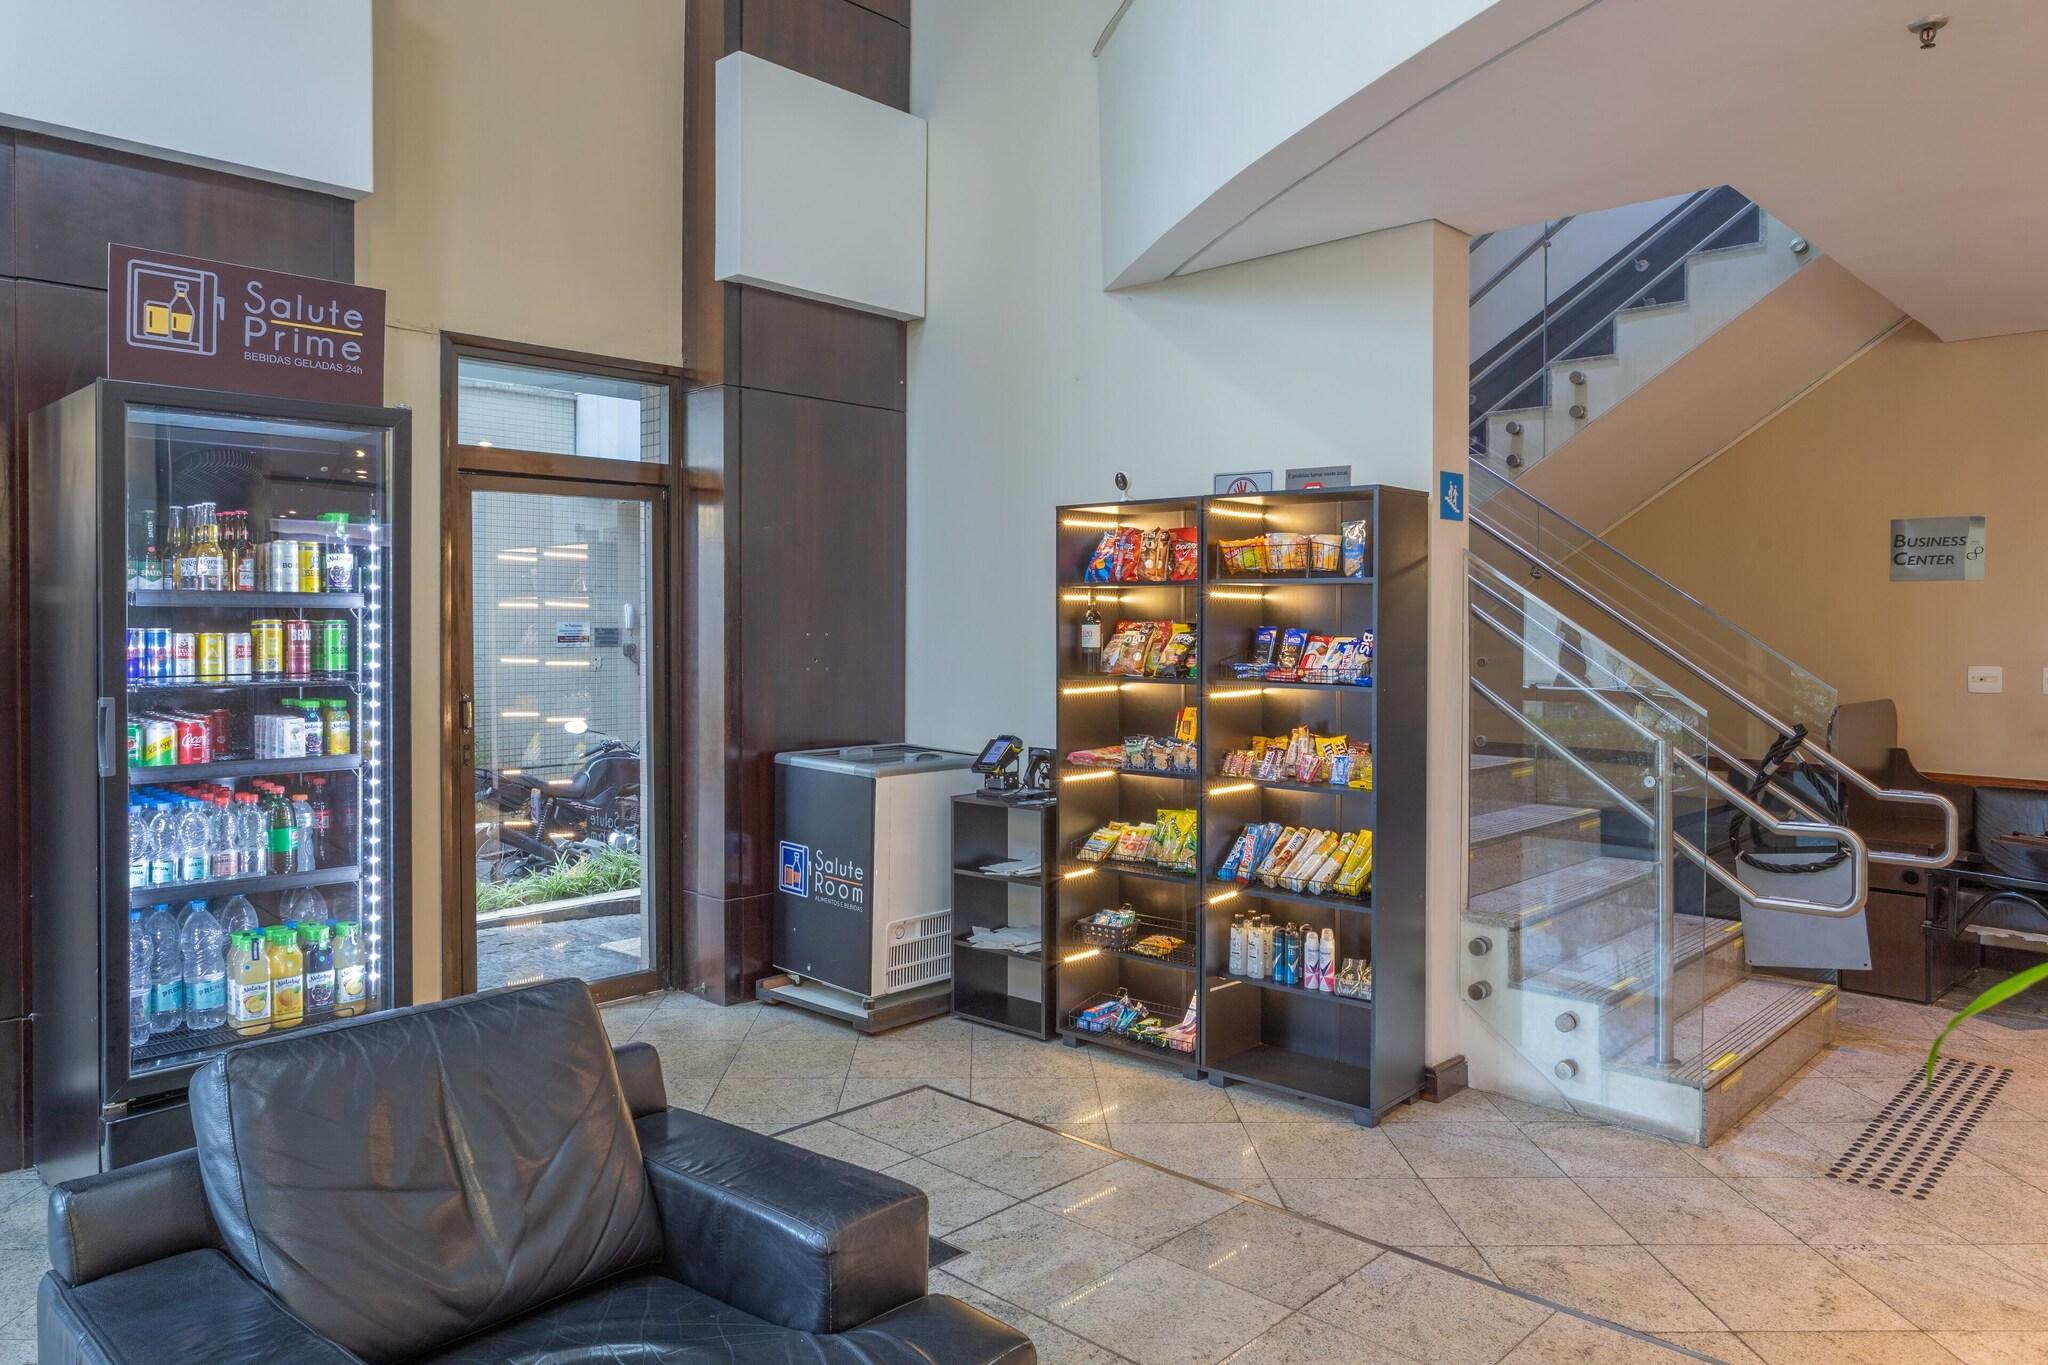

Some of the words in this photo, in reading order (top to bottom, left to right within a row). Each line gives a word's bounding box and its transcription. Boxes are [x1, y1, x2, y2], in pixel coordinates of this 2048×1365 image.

[244, 280, 364, 329] Salute
[244, 316, 363, 361] Prime
[244, 351, 292, 366] BEBIDAS
[294, 358, 344, 373] GELADAS
[345, 364, 363, 375] 24h
[1892, 534, 1967, 548] BUSINESS
[1893, 552, 1955, 566] CENTER
[815, 849, 863, 881] Salute
[815, 871, 863, 904] Room
[815, 895, 840, 907] ALIMENTOS
[844, 902, 863, 913] BEBIDAS
